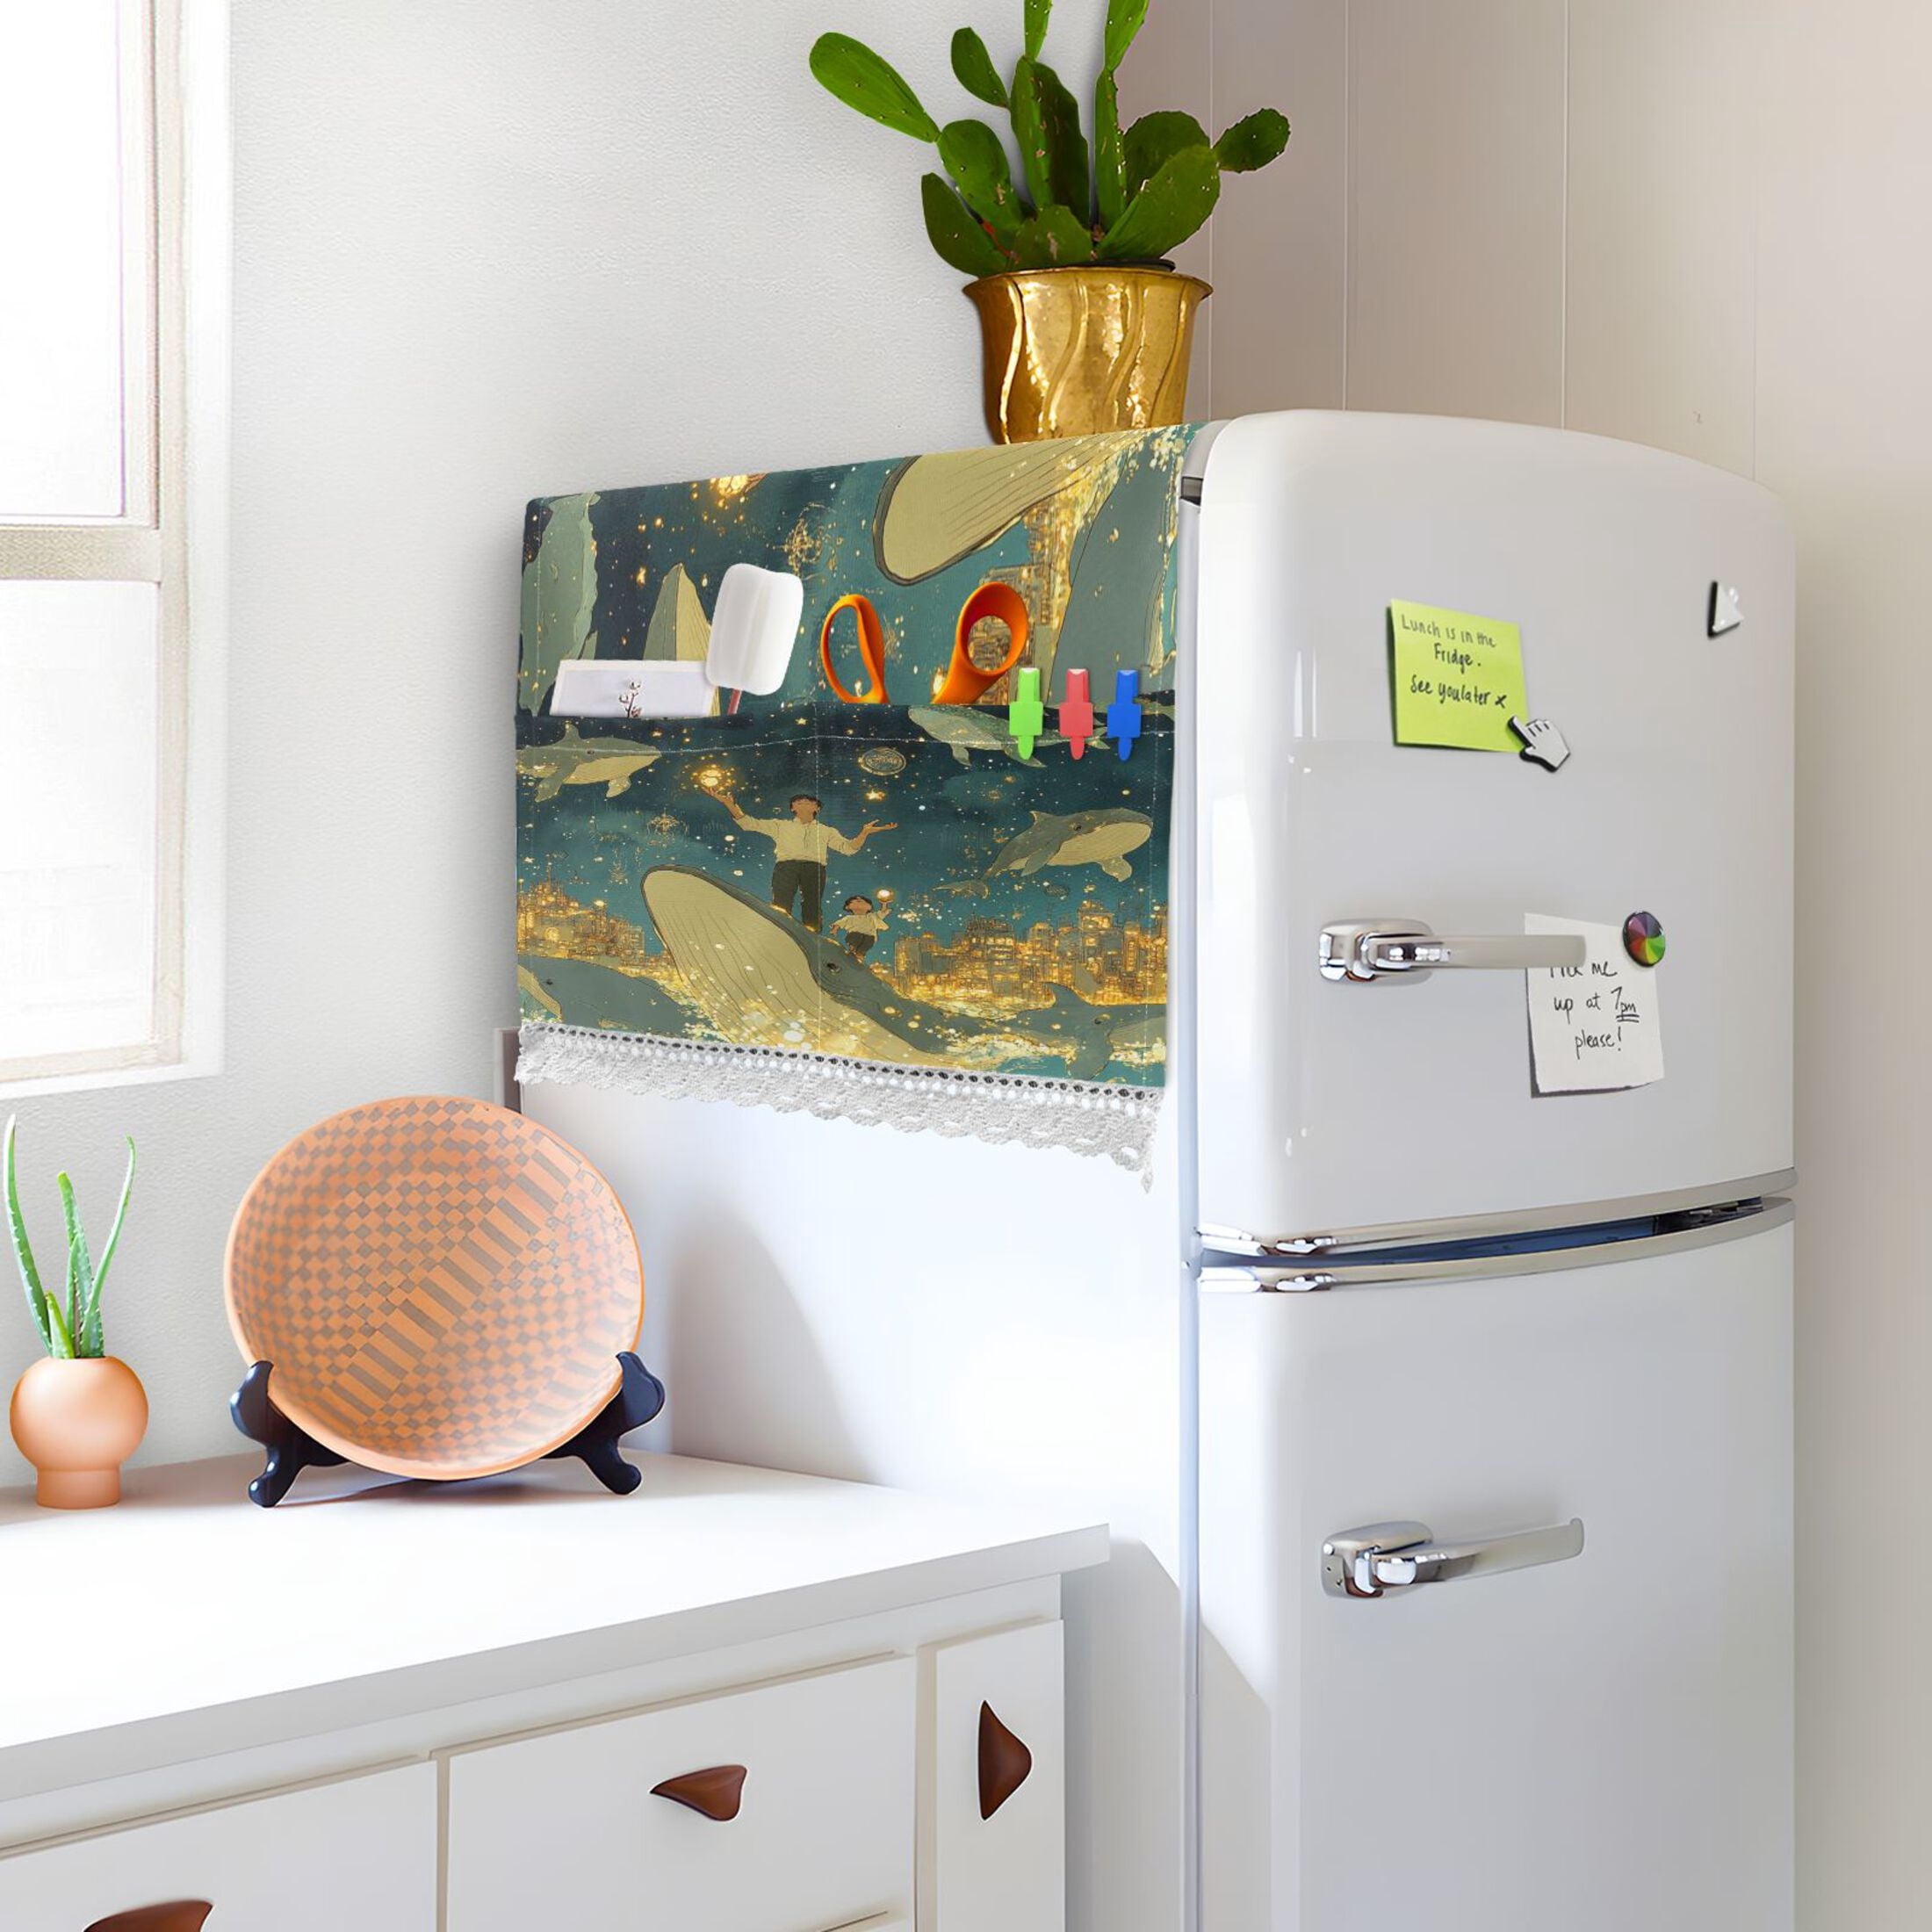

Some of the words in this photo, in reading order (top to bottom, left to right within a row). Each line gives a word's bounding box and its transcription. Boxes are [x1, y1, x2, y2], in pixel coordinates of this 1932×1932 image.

[1401, 614, 1440, 638] Lunch
[1445, 627, 1455, 640] is
[1461, 631, 1474, 644] in
[1477, 632, 1496, 648] the
[1410, 674, 1433, 694] See
[1591, 961, 1618, 977] me
[1554, 997, 1574, 1024] up
[1586, 992, 1601, 1010] at
[1575, 1026, 1622, 1060] please!
